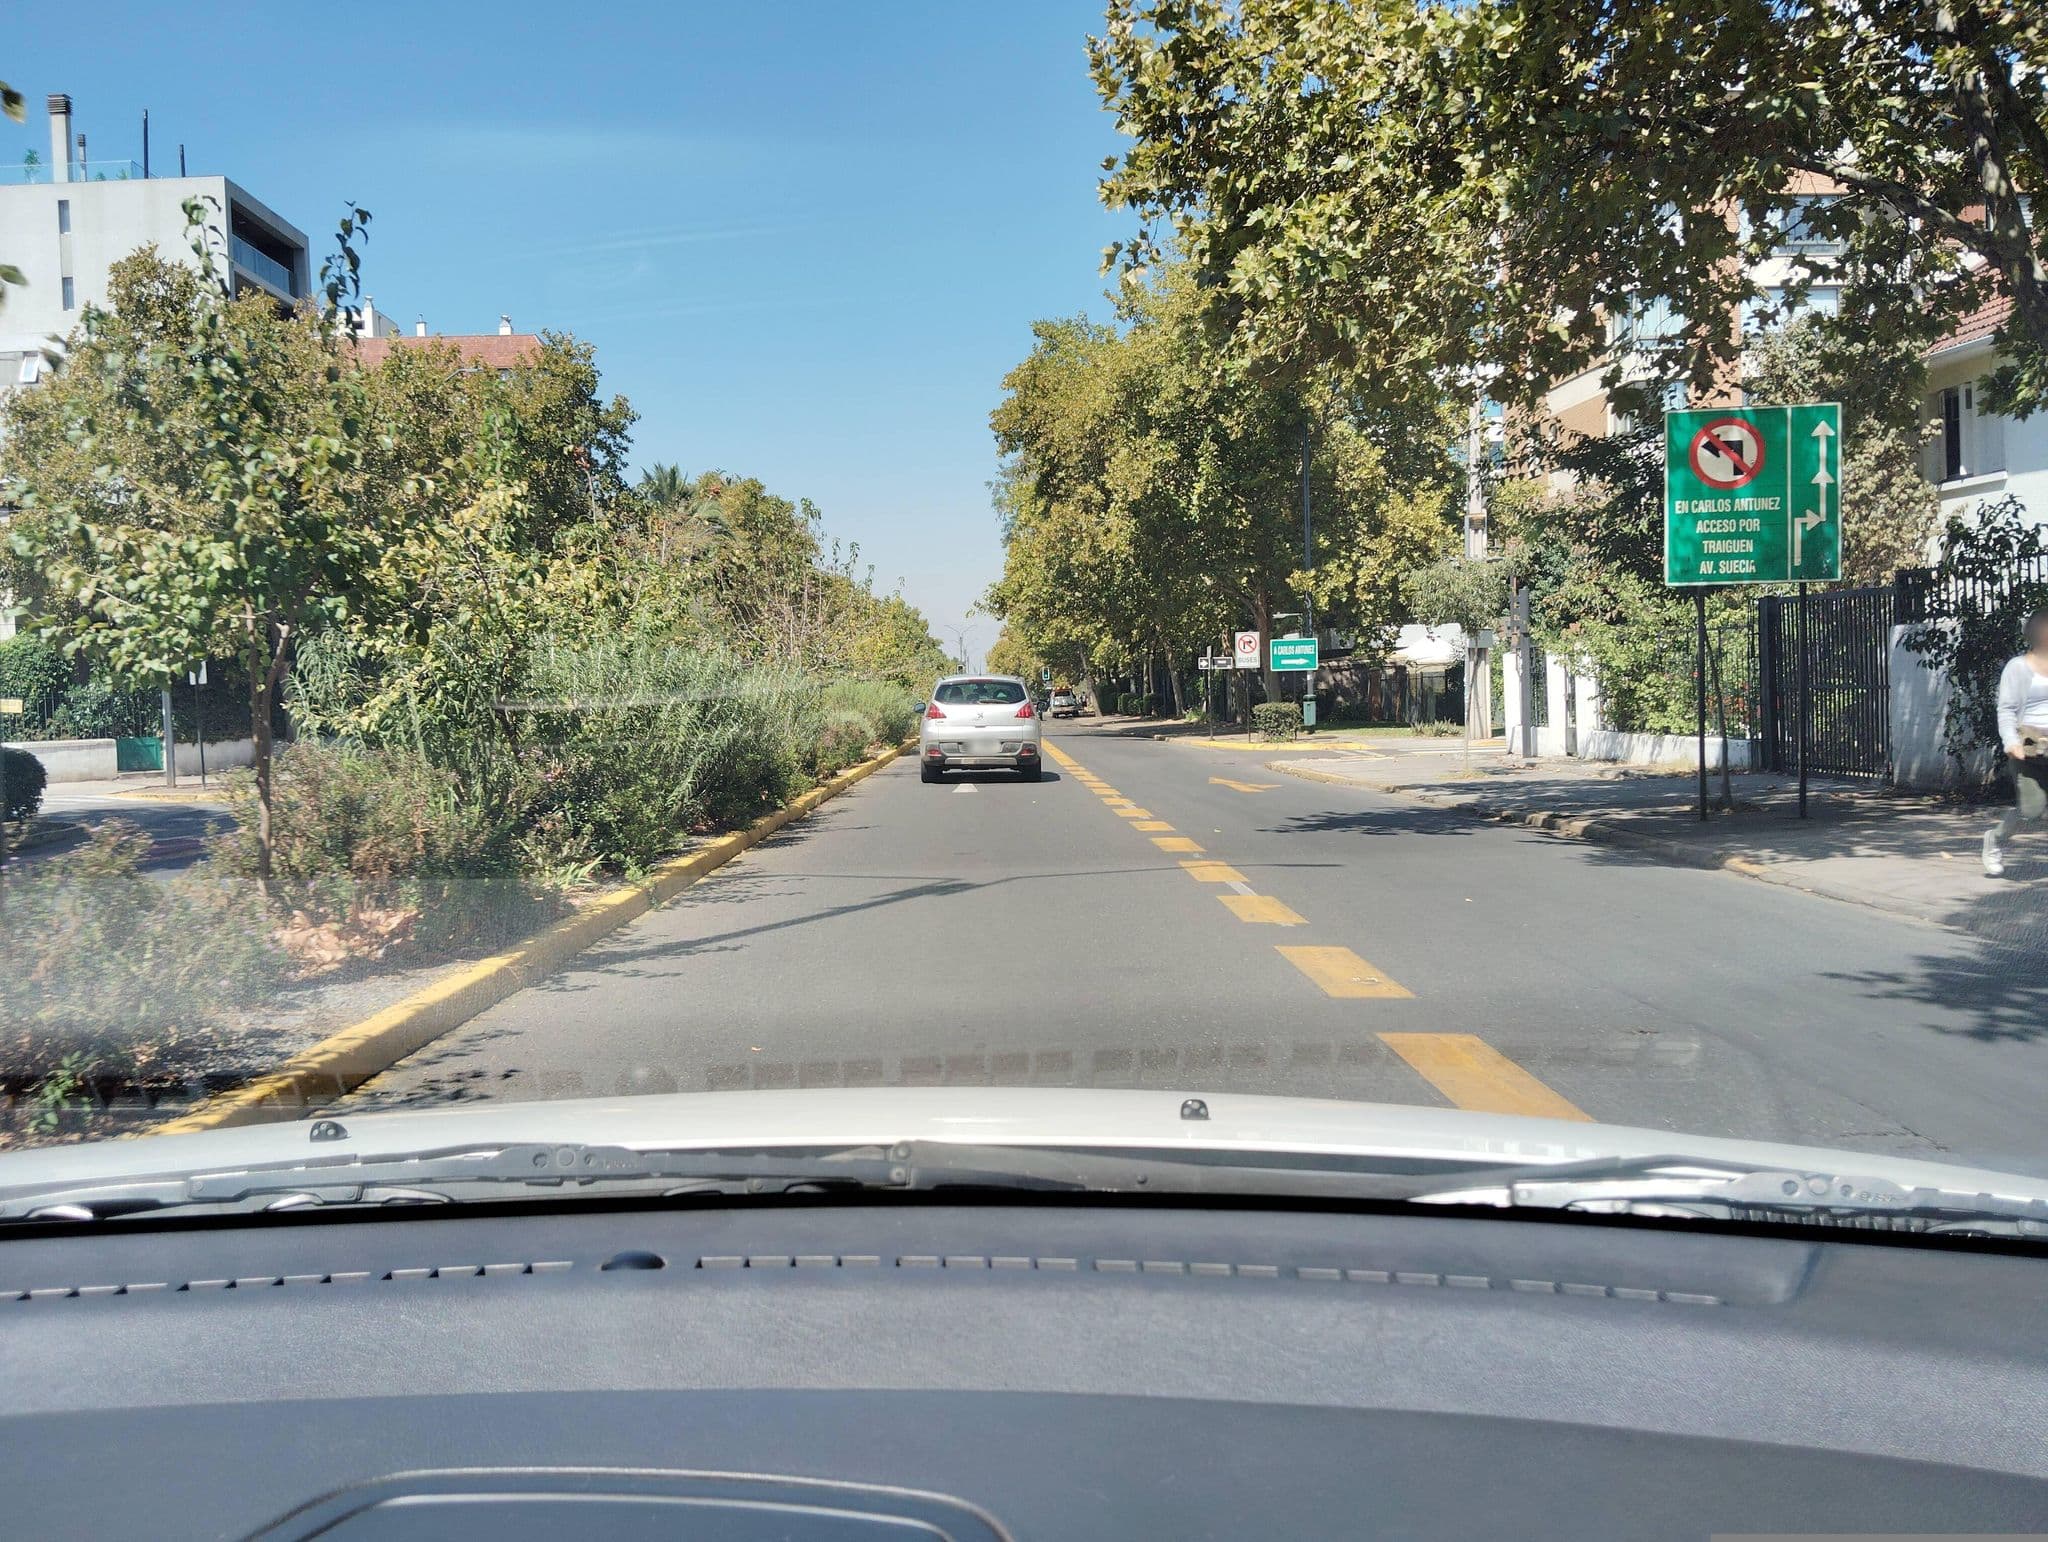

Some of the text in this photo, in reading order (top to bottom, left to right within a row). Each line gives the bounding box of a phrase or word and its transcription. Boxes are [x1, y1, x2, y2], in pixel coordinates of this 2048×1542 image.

[1675, 497, 1781, 513] EN CARLOS ANTUNEZ
[1696, 518, 1760, 533] ACCESO POR
[1702, 540, 1753, 554] TRAIGUEN
[1700, 560, 1756, 574] AV. SUECIA
